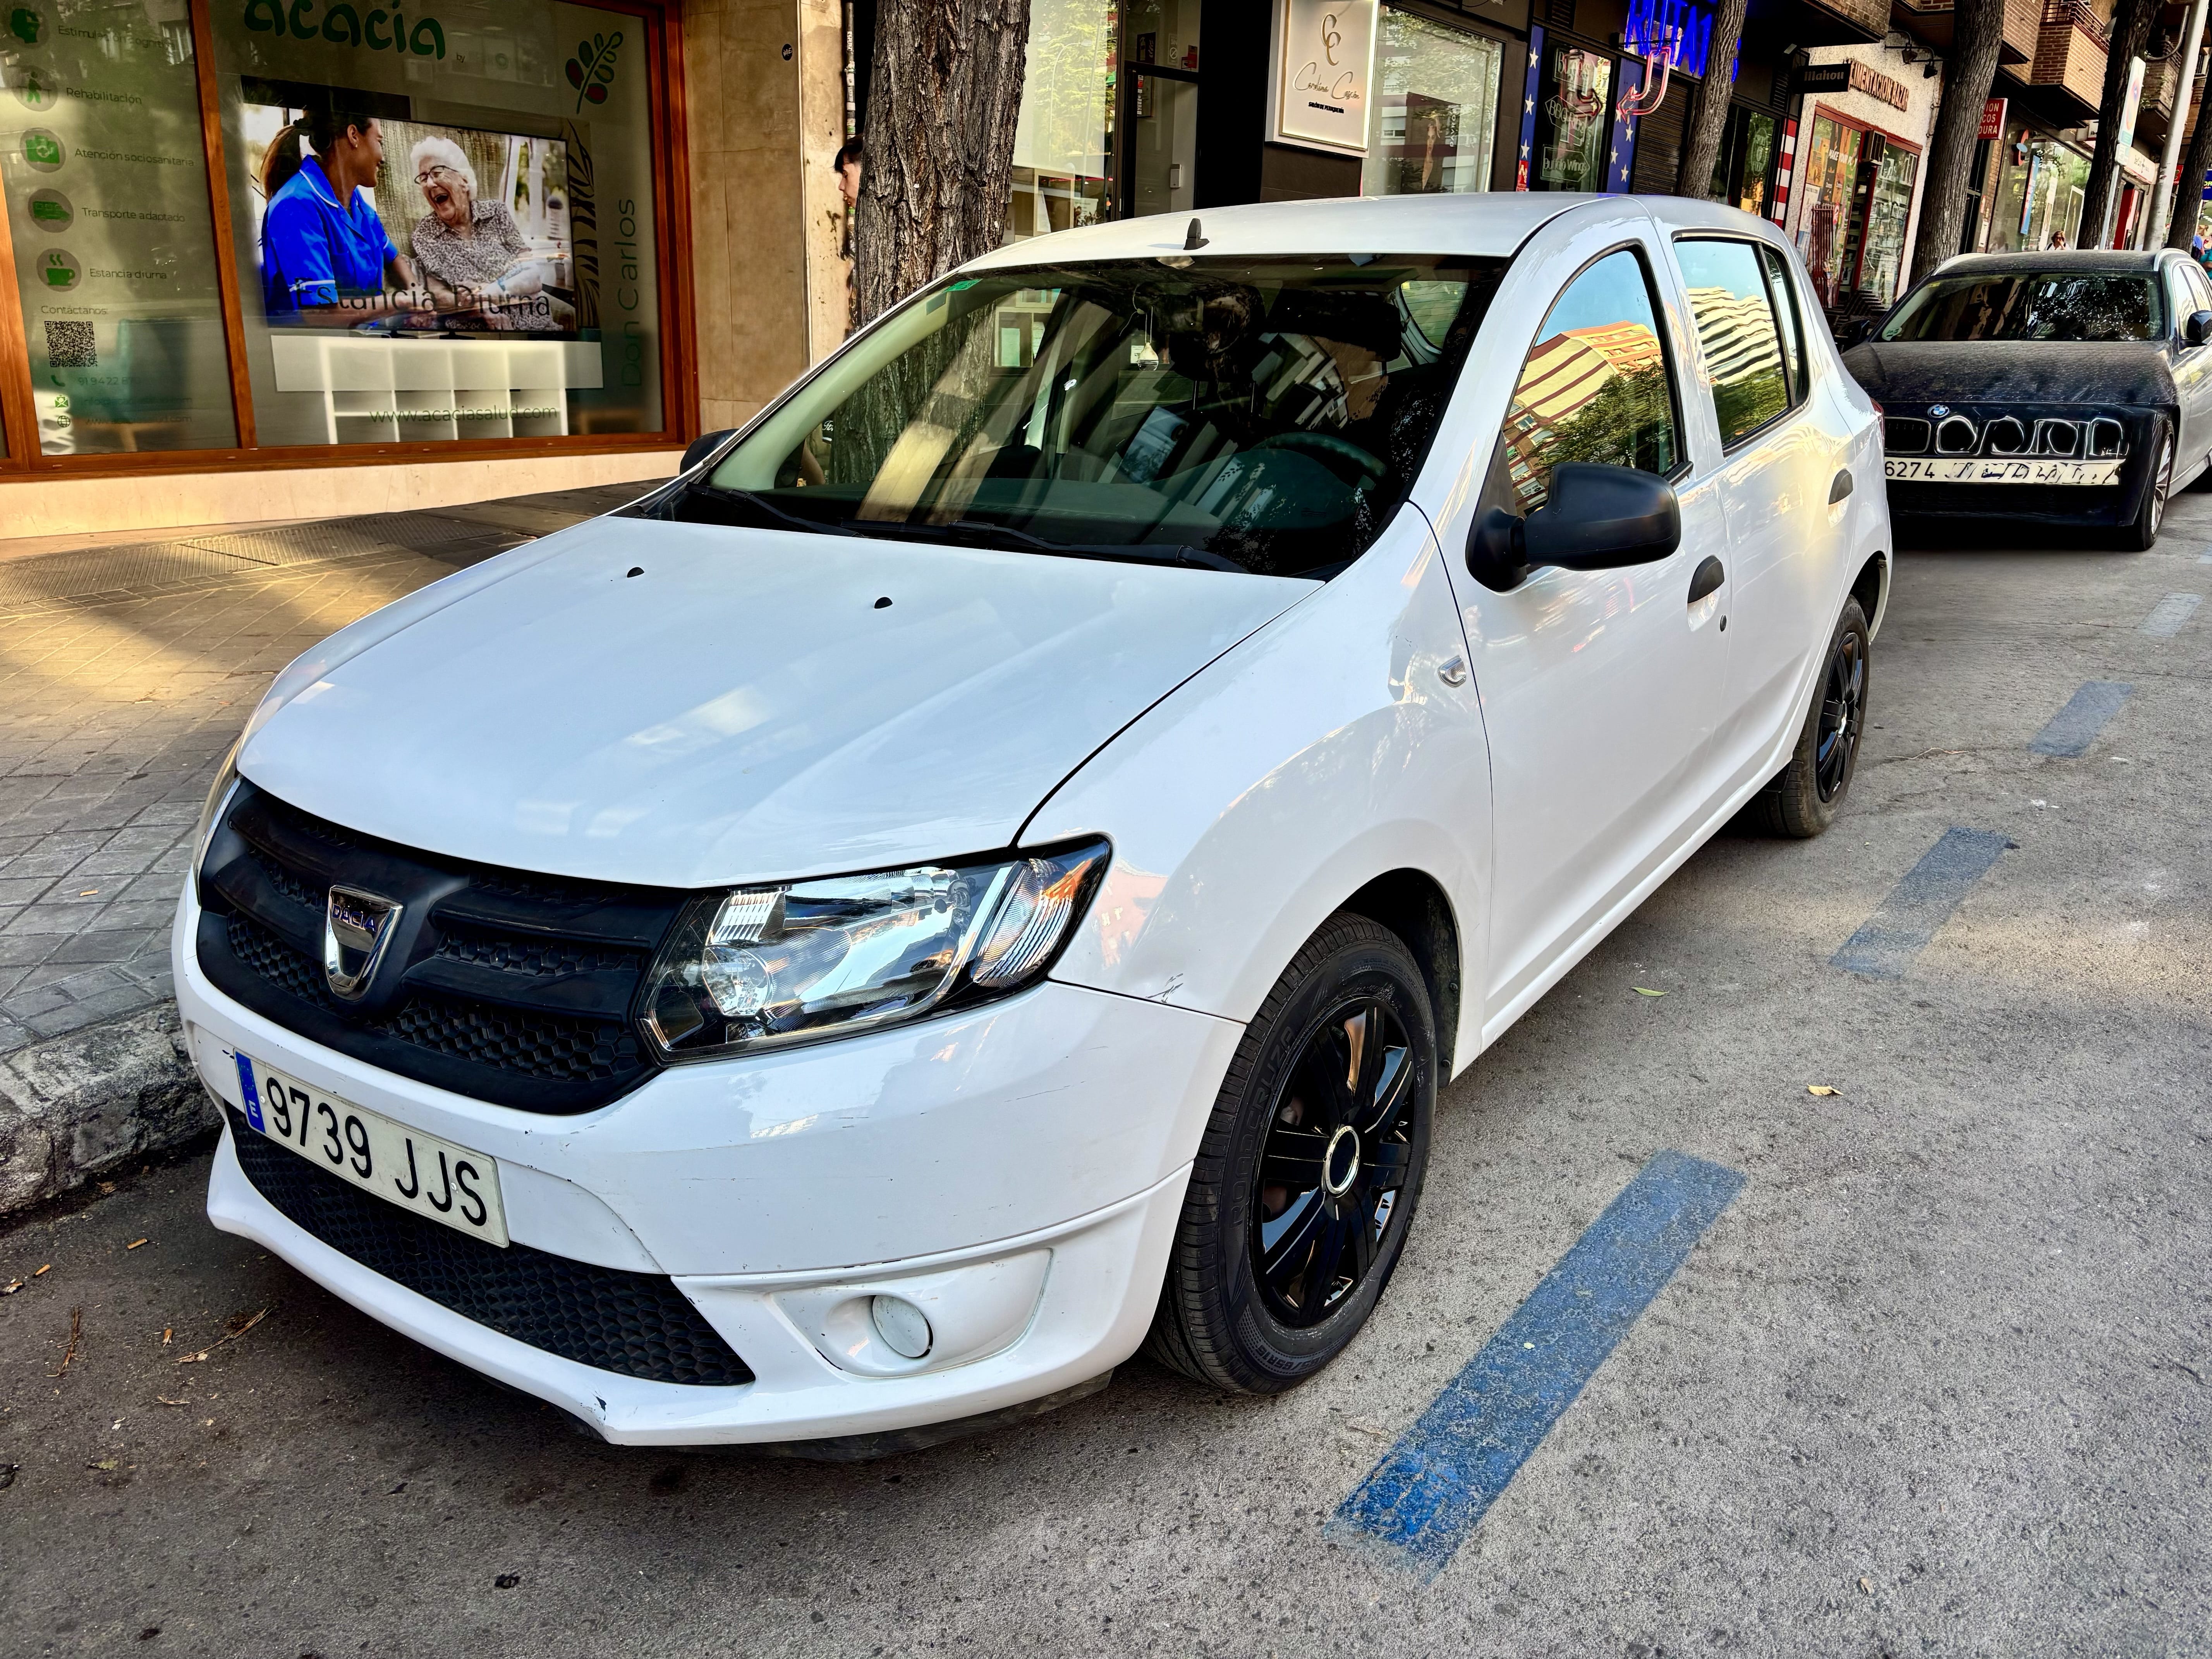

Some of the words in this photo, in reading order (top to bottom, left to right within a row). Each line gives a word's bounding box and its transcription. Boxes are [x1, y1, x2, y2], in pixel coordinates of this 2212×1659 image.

[456, 53, 465, 63] by
[1804, 70, 1844, 81] Mahou
[1843, 58, 1892, 103] LIMENTACION
[66, 88, 142, 105] Rehabilitación
[1549, 100, 1568, 123] BBQ
[1985, 103, 1999, 112] ION
[74, 148, 123, 161] Atención
[124, 153, 194, 167] sociosanitaria
[82, 207, 137, 220] Transporte
[139, 211, 185, 223] adaptado
[613, 199, 639, 311] Carlos
[90, 268, 132, 279] Estancia
[135, 268, 167, 280] diurna
[296, 276, 435, 312] Estancia
[453, 284, 550, 316] Diurna
[369, 404, 558, 423] www.acaciasalud.com
[1885, 461, 1936, 479] 6274
[331, 903, 378, 932] DACIA
[248, 1100, 259, 1118] E
[265, 1076, 373, 1180] 9739
[394, 1137, 488, 1227] JJS
